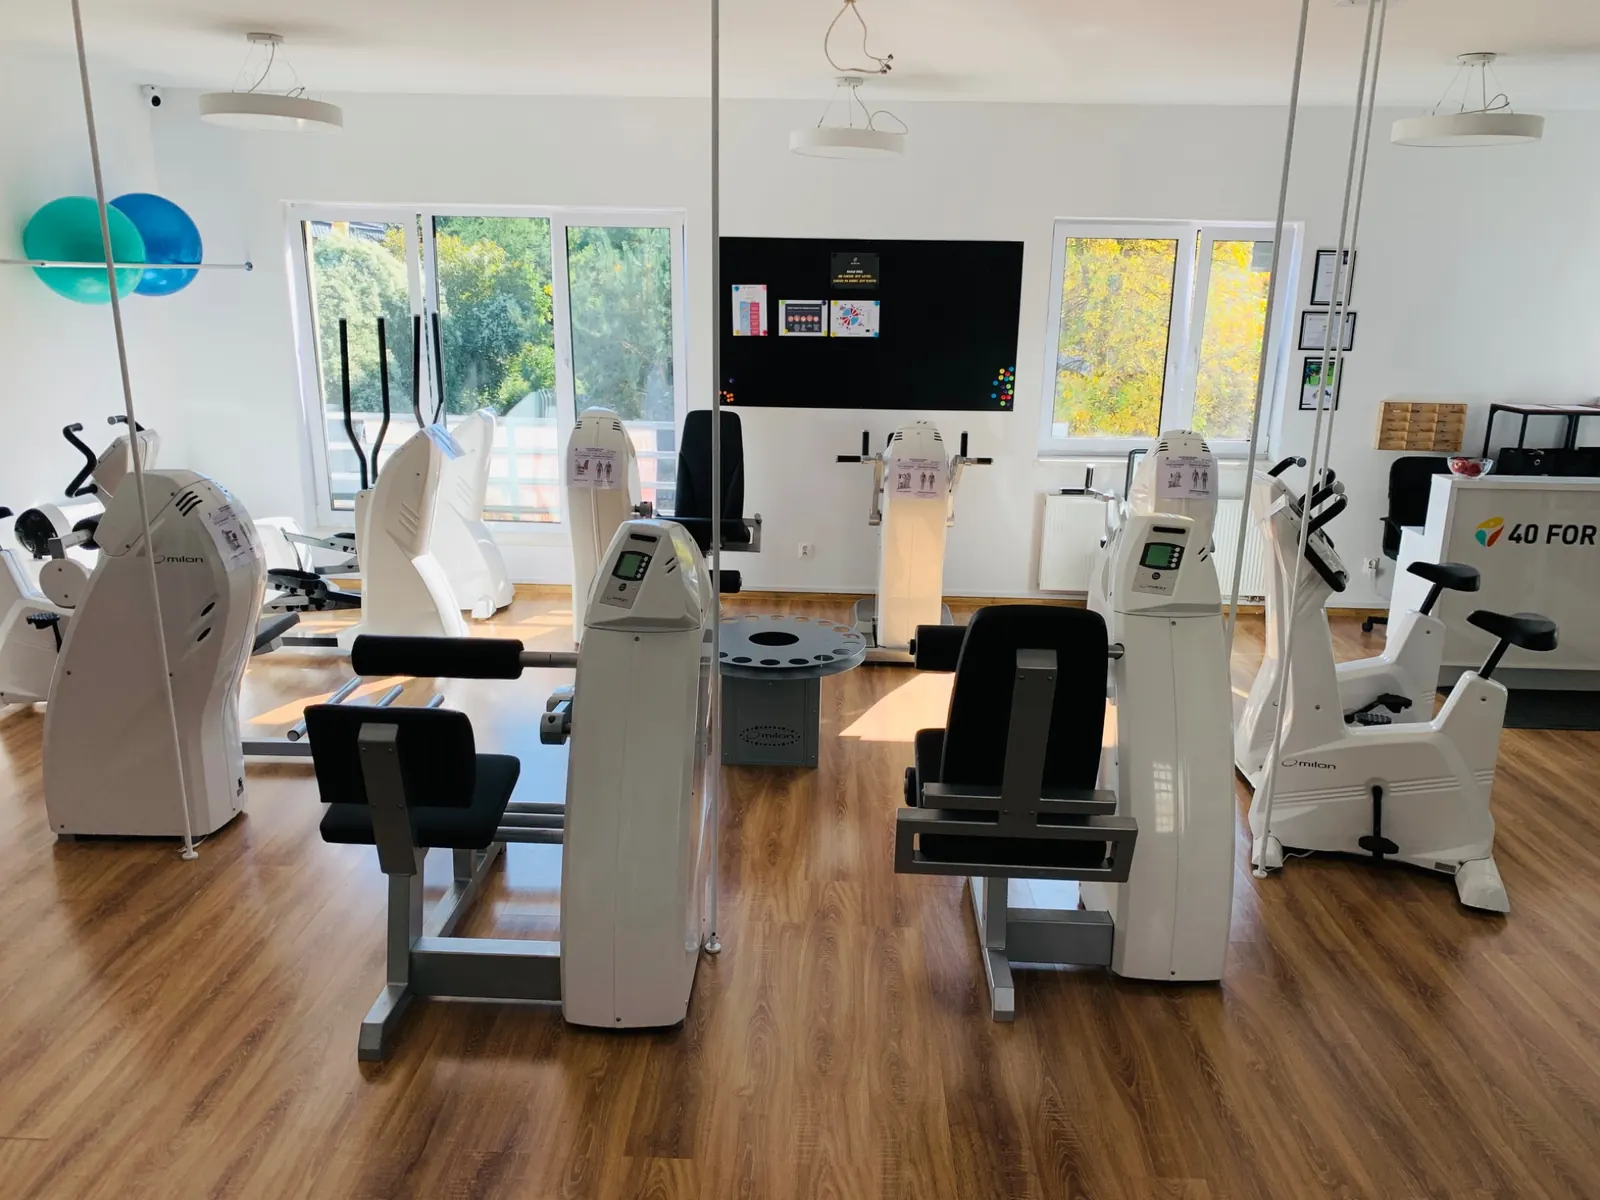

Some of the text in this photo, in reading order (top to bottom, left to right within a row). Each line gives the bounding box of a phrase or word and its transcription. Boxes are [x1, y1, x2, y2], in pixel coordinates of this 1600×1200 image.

[1508, 523, 1597, 546] 40 FOR
[166, 555, 204, 563] milon
[1299, 761, 1337, 770] milon
